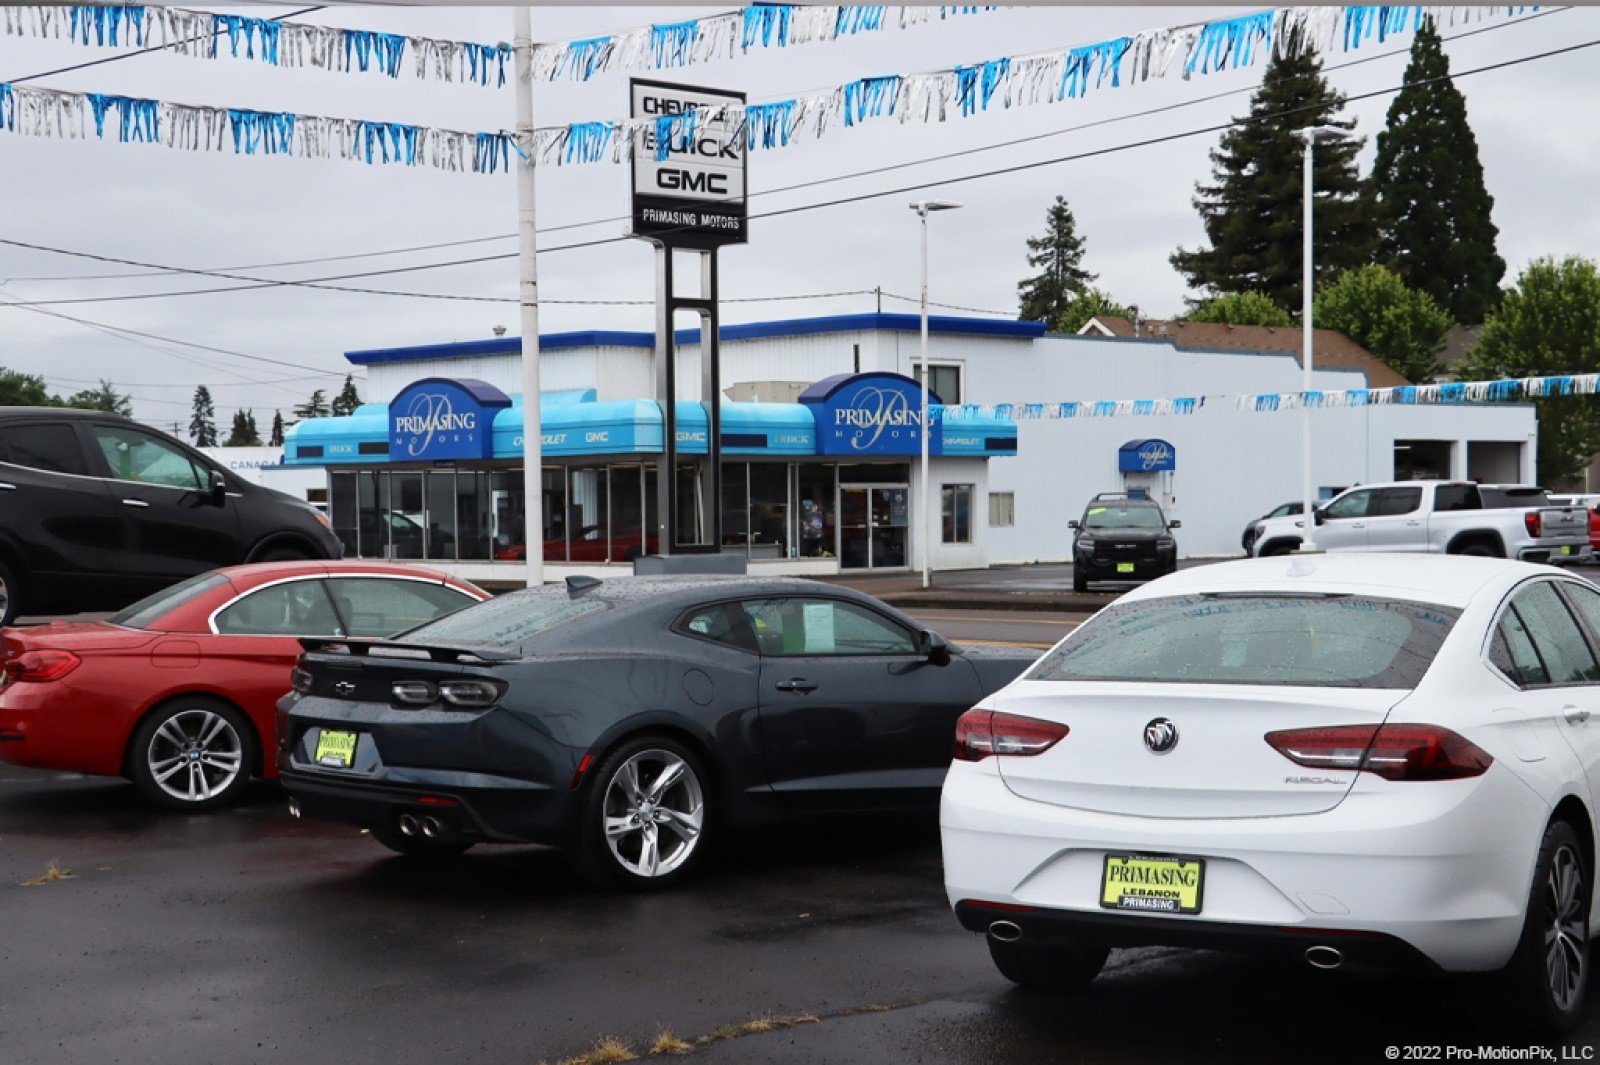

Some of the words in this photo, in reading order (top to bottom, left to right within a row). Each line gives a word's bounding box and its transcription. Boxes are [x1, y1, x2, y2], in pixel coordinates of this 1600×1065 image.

[656, 167, 728, 194] GMC
[643, 208, 697, 226] PRIMASING
[701, 214, 740, 230] MOTORS
[395, 412, 476, 433] PRIMASING
[585, 431, 609, 443] GMC
[675, 431, 706, 442] GMC
[1109, 864, 1198, 887] PRIMASING
[1122, 887, 1180, 898] LEBANON
[1122, 896, 1175, 910] PRIMASING
